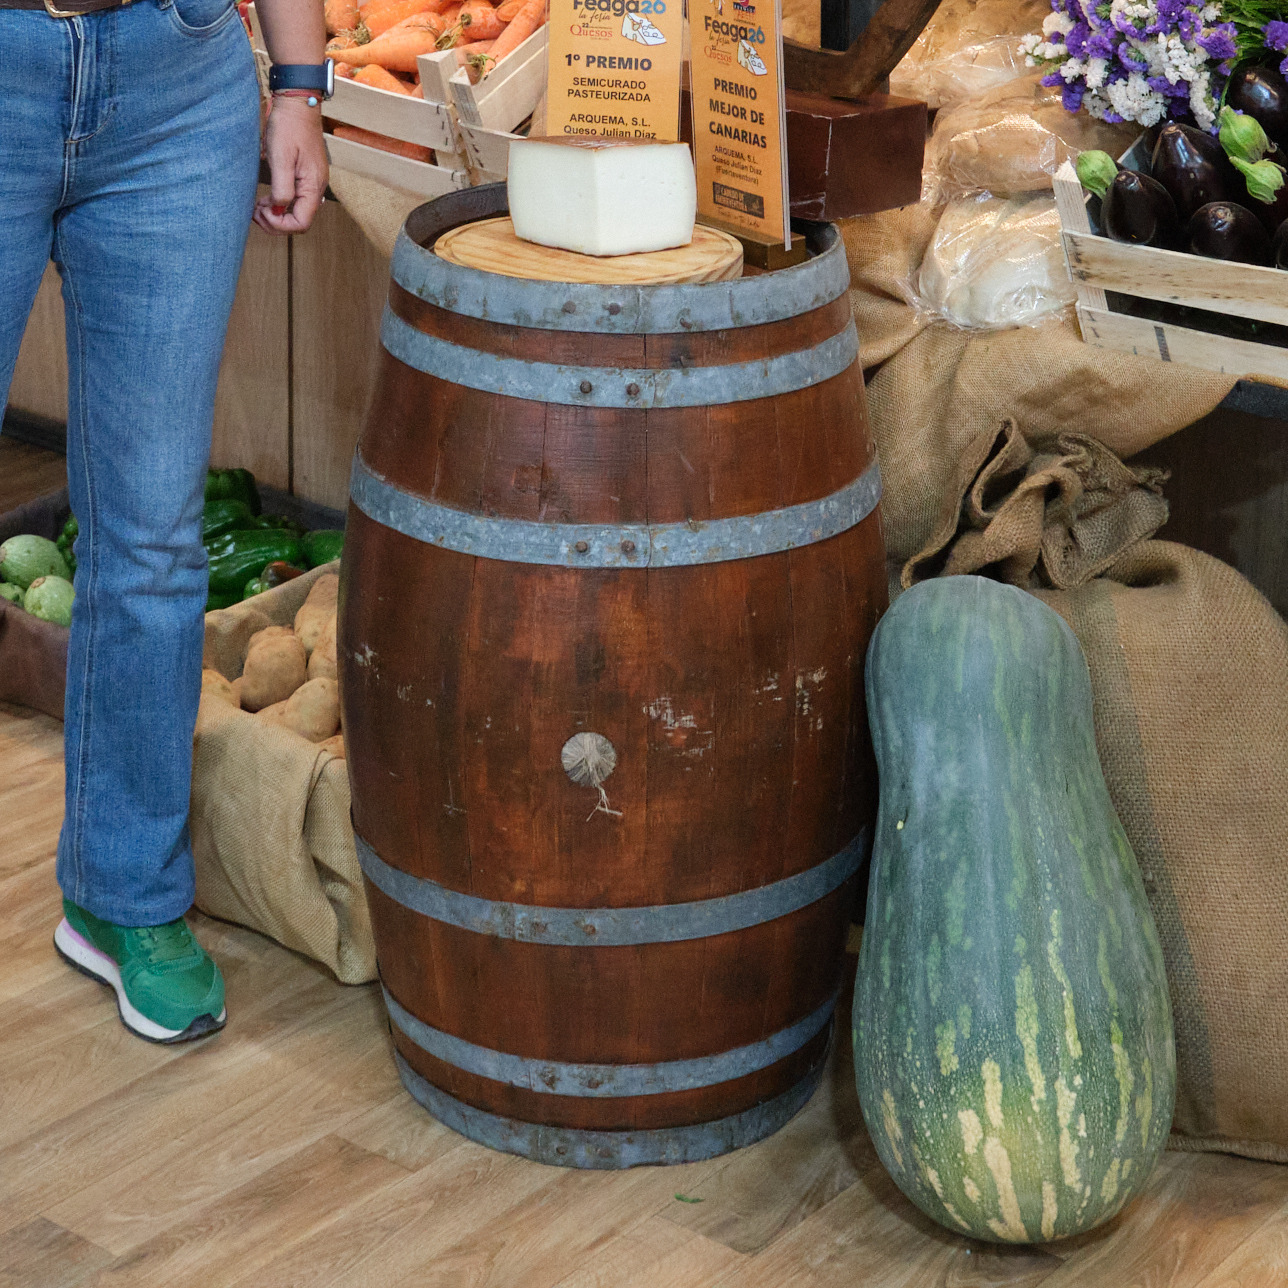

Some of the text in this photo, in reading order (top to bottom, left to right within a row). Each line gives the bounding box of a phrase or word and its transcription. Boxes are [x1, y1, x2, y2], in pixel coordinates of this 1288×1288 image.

[570, 24, 612, 37] Quesos
[705, 16, 765, 44] Feaga26
[586, 55, 652, 71] PREMIO
[573, 78, 646, 90] SEMICURADO
[714, 78, 757, 100] PREMIO
[567, 89, 650, 102] PASTEURIZADA
[709, 98, 765, 125] MEJOR DE
[570, 114, 650, 127] ARQUEMA, S.L.
[564, 125, 596, 136] Queso
[709, 121, 767, 148] CANARIAS
[712, 154, 730, 166] Queso
